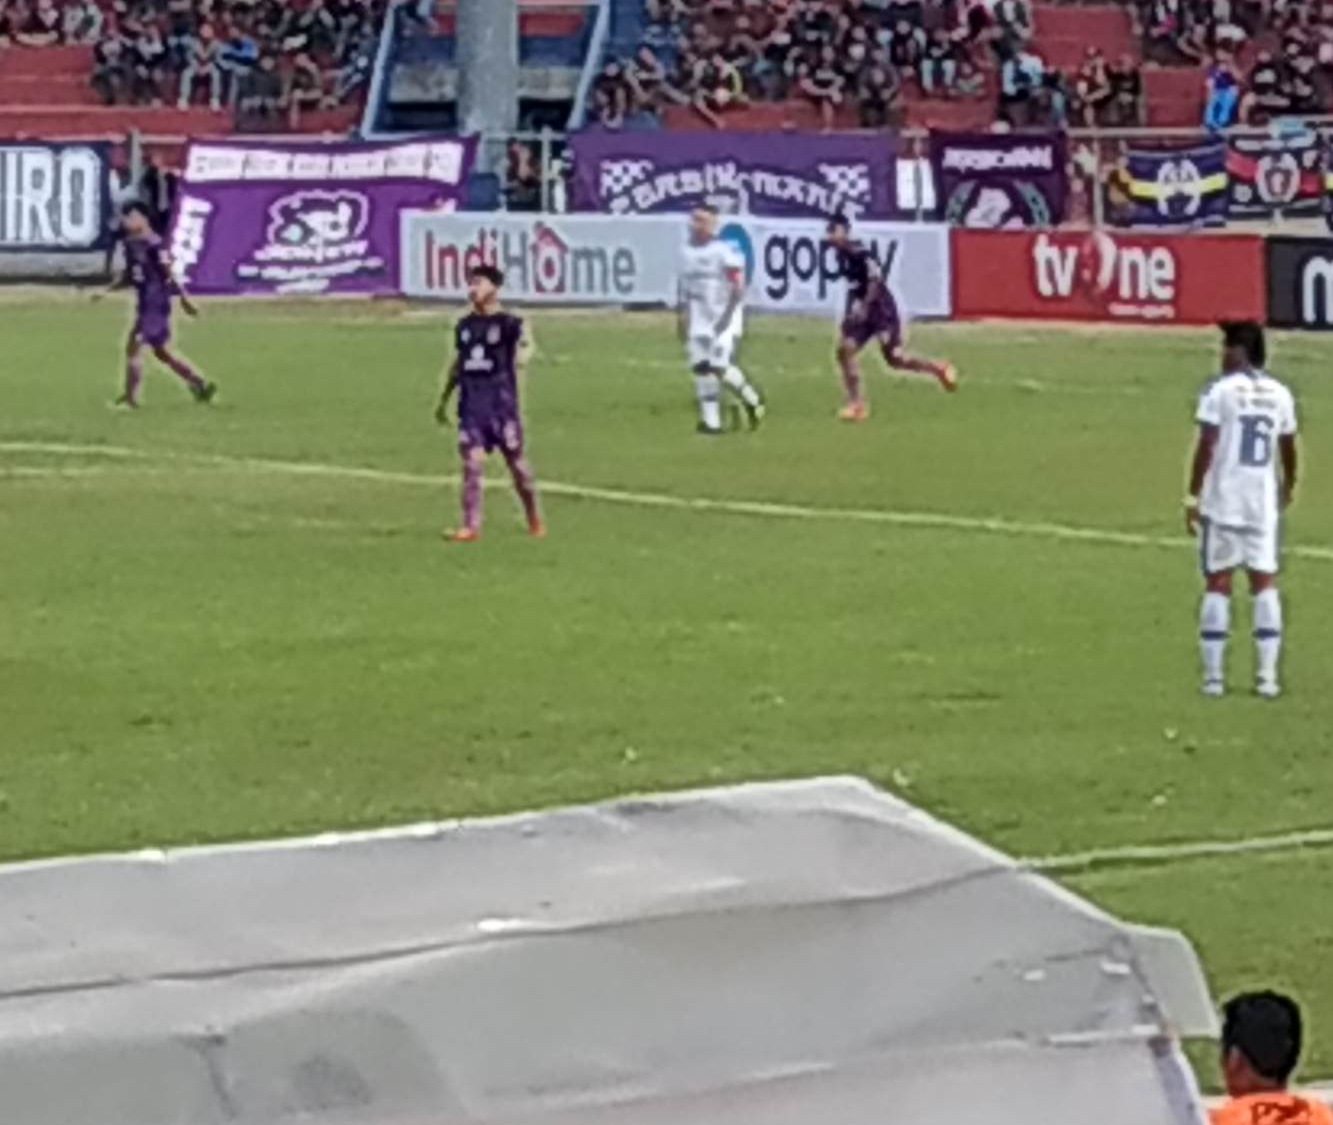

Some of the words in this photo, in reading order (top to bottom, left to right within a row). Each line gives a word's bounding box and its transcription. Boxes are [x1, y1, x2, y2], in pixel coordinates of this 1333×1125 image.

[425, 221, 636, 294] IndiHome
[764, 234, 897, 299] gopy
[1032, 232, 1176, 300] tvOne
[1239, 415, 1274, 466] 16
